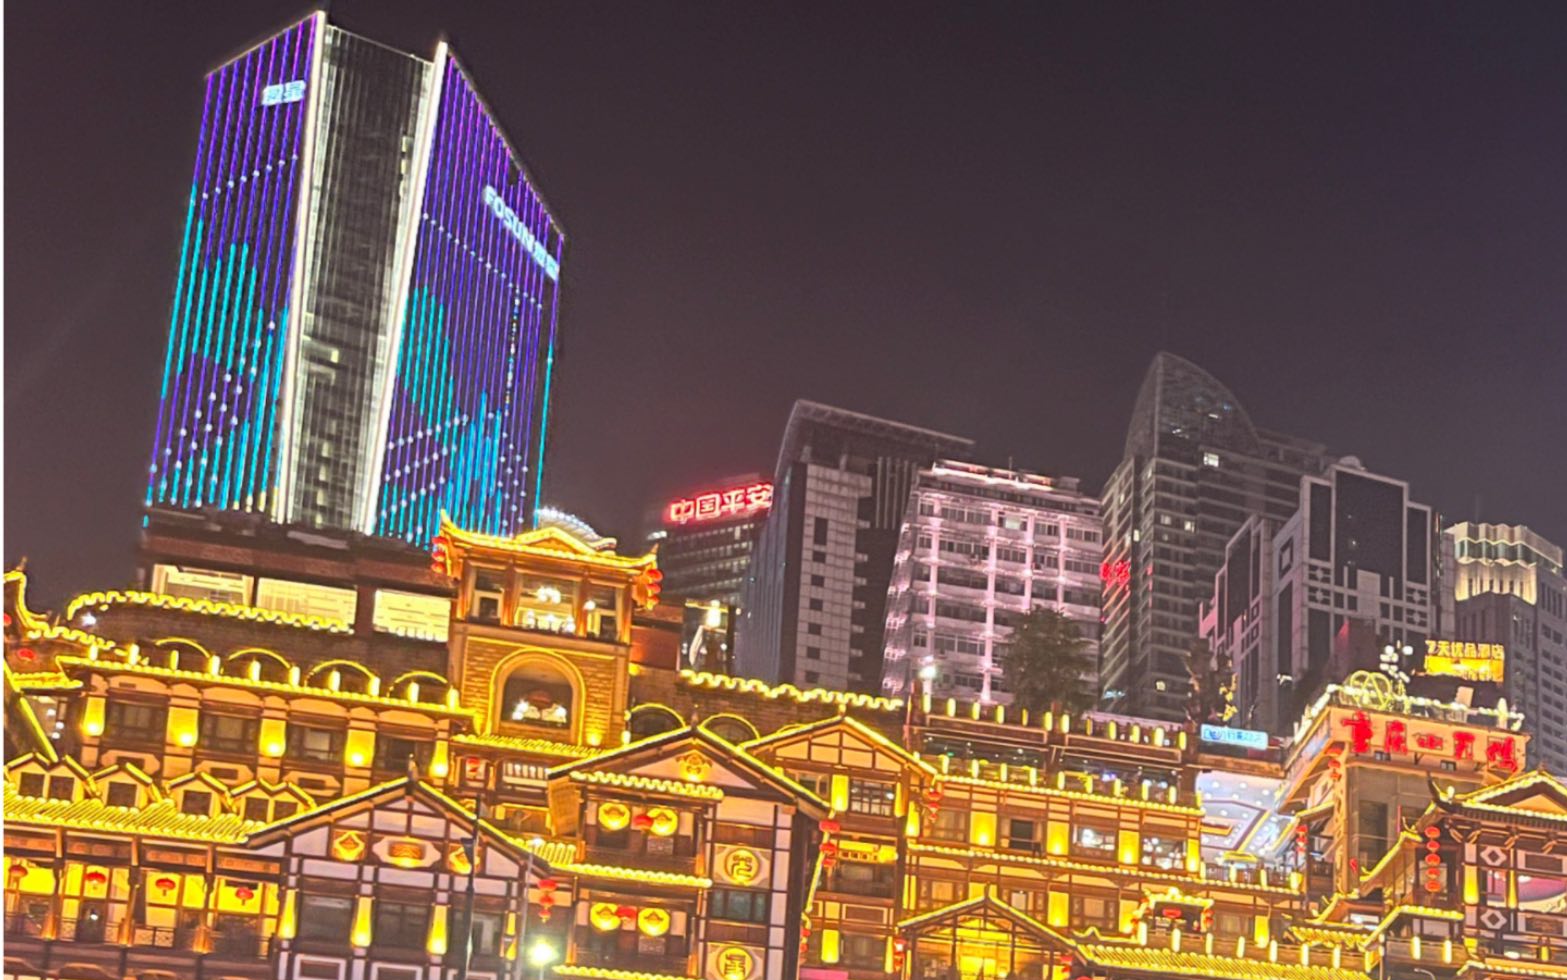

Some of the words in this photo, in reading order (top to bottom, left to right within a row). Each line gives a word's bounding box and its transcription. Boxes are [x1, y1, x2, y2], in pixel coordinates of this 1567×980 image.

[484, 185, 535, 253] FOSUN
[670, 484, 774, 524] 中国平安
